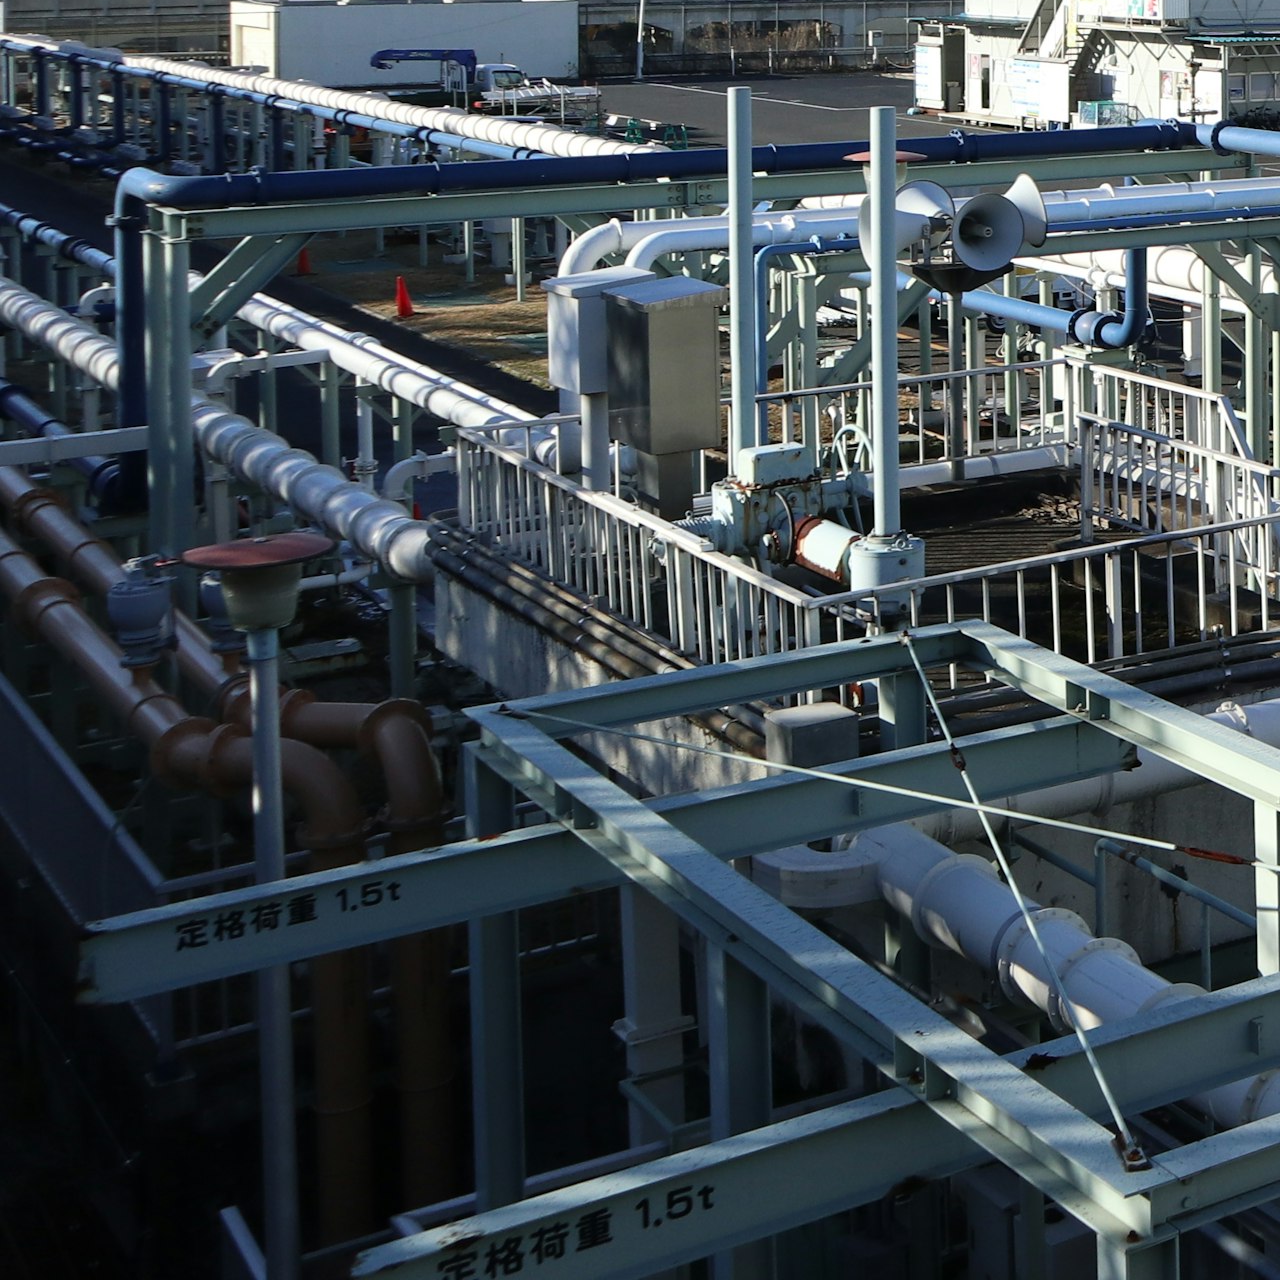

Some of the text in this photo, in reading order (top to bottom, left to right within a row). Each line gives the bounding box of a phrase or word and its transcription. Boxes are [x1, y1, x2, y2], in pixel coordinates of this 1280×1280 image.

[175, 880, 401, 952] 定格荷重 1.5t
[437, 1184, 715, 1280] 定格荷重 1.5t
